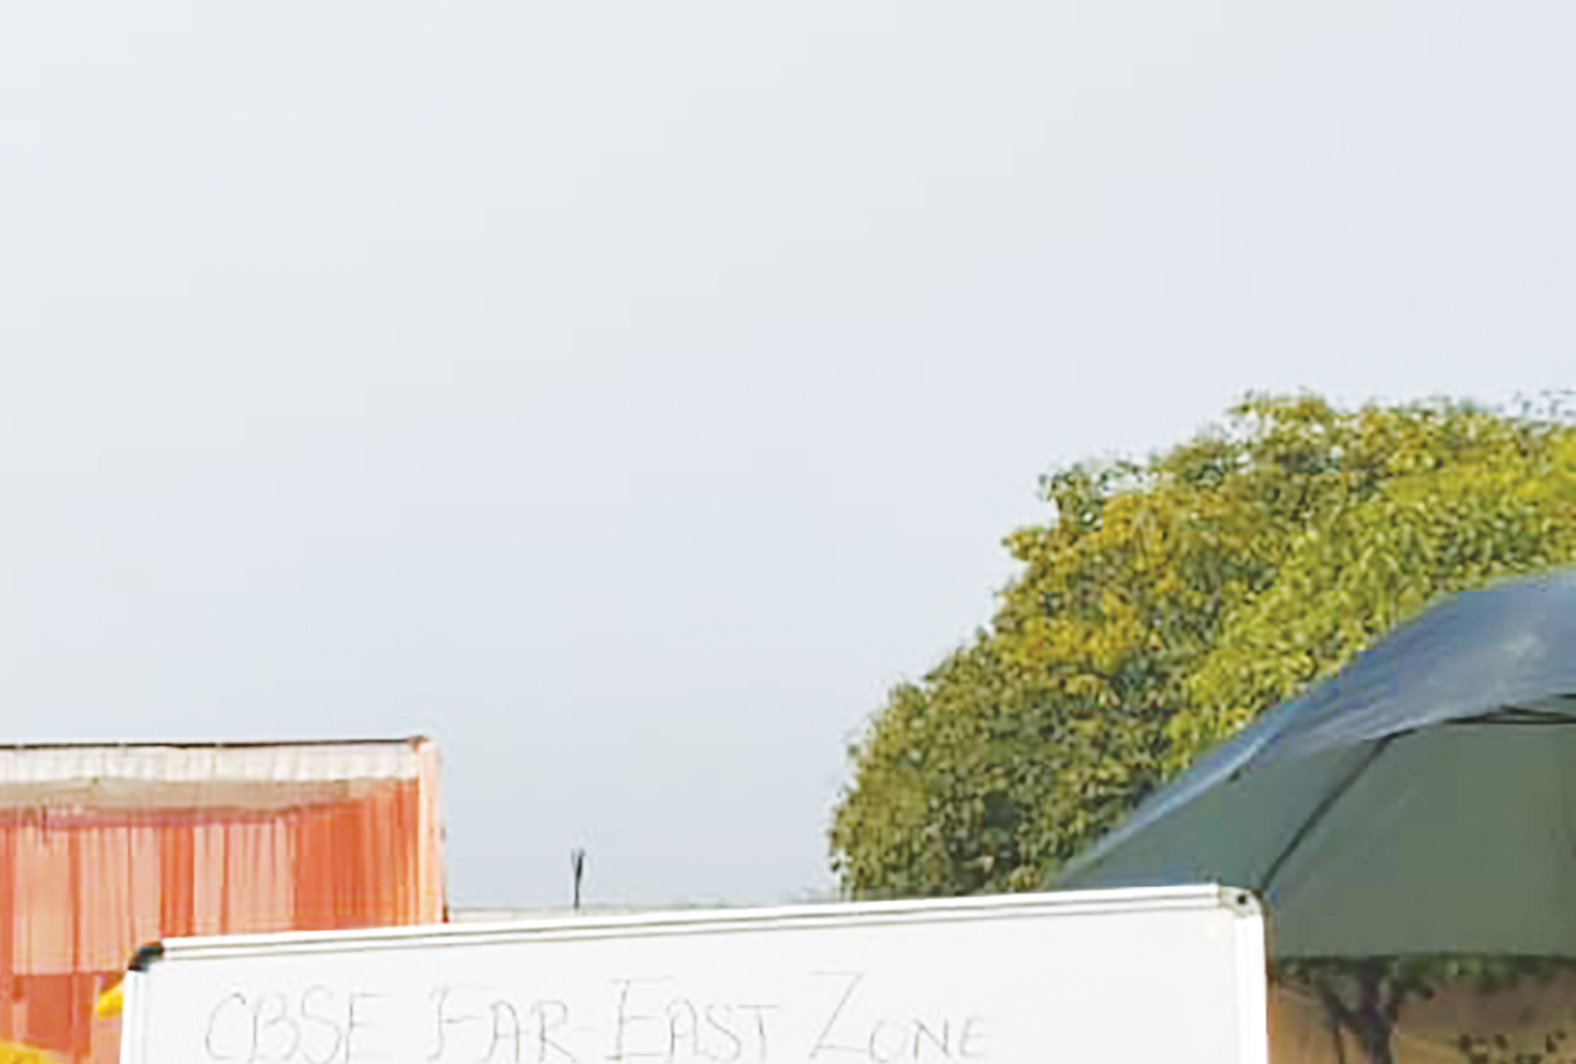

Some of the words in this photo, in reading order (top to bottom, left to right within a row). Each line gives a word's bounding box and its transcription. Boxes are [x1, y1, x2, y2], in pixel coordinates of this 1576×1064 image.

[428, 984, 579, 1064] FAR
[605, 976, 781, 1064] EAST
[808, 970, 993, 1064] ZONE
